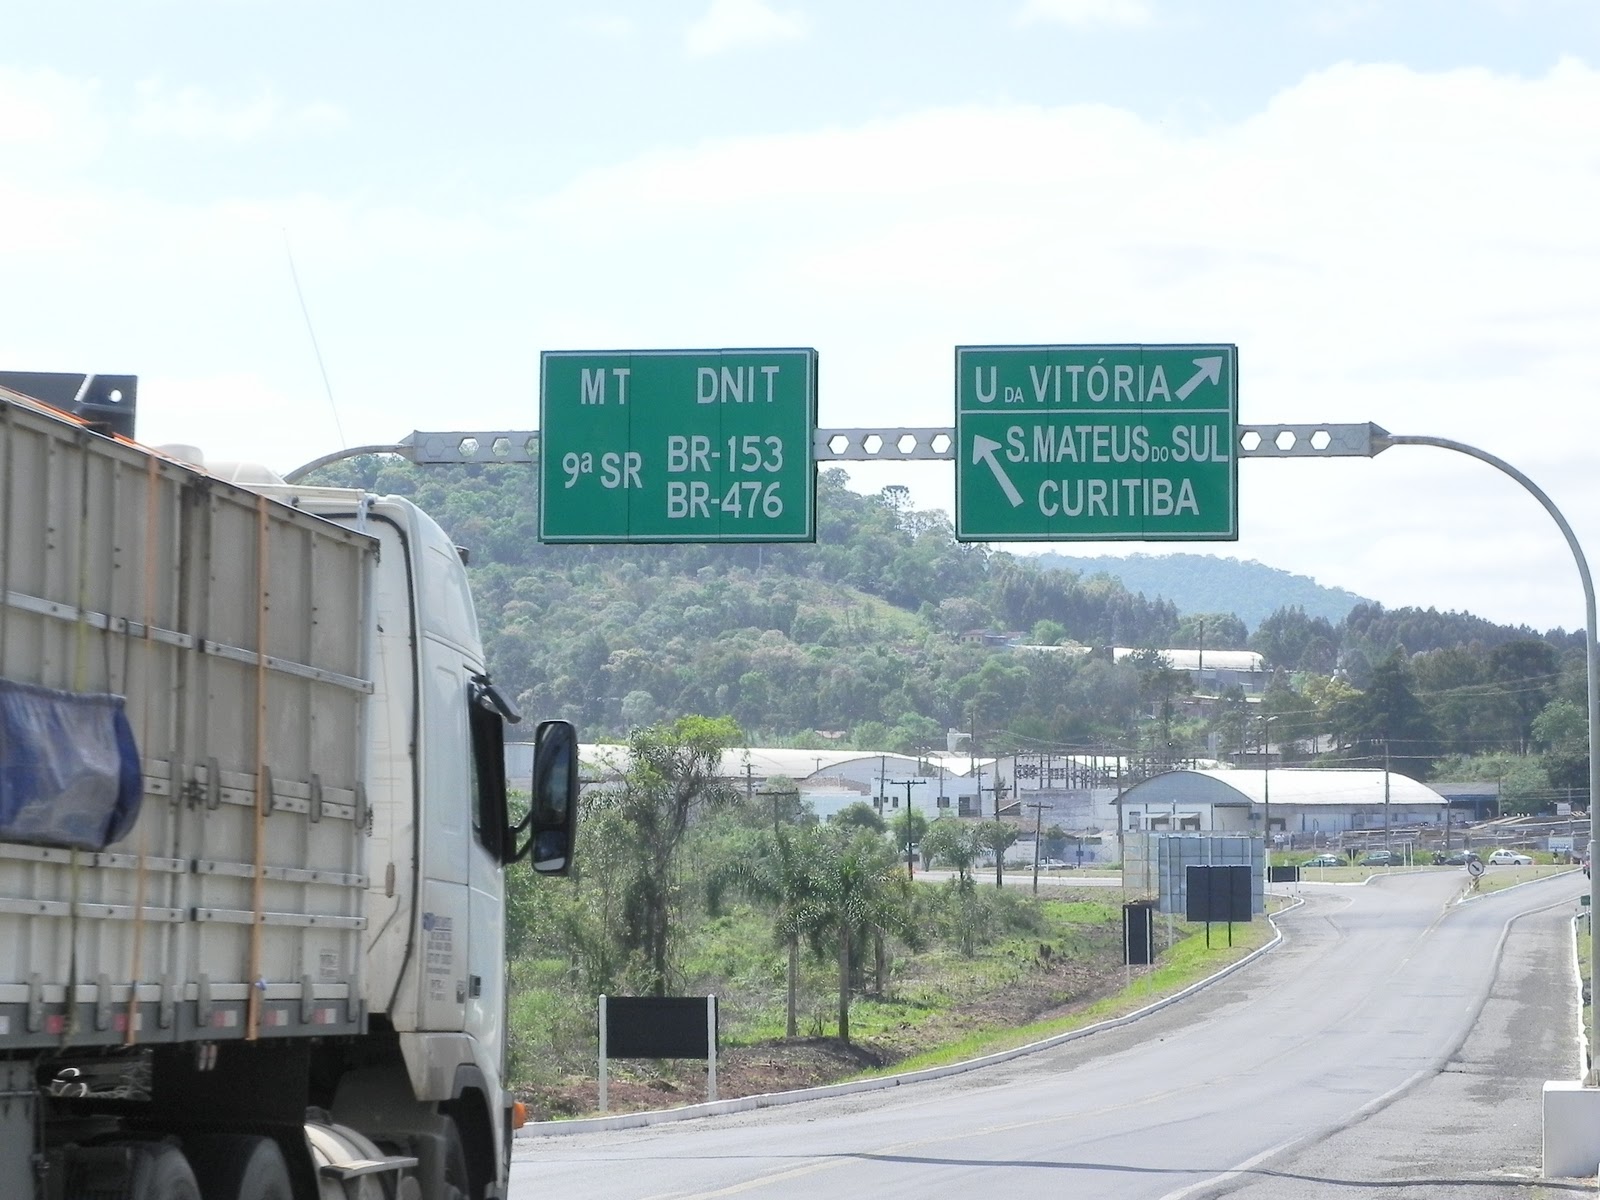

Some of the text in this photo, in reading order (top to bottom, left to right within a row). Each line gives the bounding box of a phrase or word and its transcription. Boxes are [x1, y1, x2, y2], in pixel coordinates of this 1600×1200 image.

[697, 366, 780, 404] DNIT
[975, 358, 1172, 403] U DA VITÓRIA
[667, 435, 784, 472] BR-153
[1151, 446, 1169, 463] DO
[1171, 425, 1229, 463] SUL
[600, 452, 643, 489] SR
[667, 481, 784, 518] BR-476
[1038, 478, 1200, 517] CURITIBA
